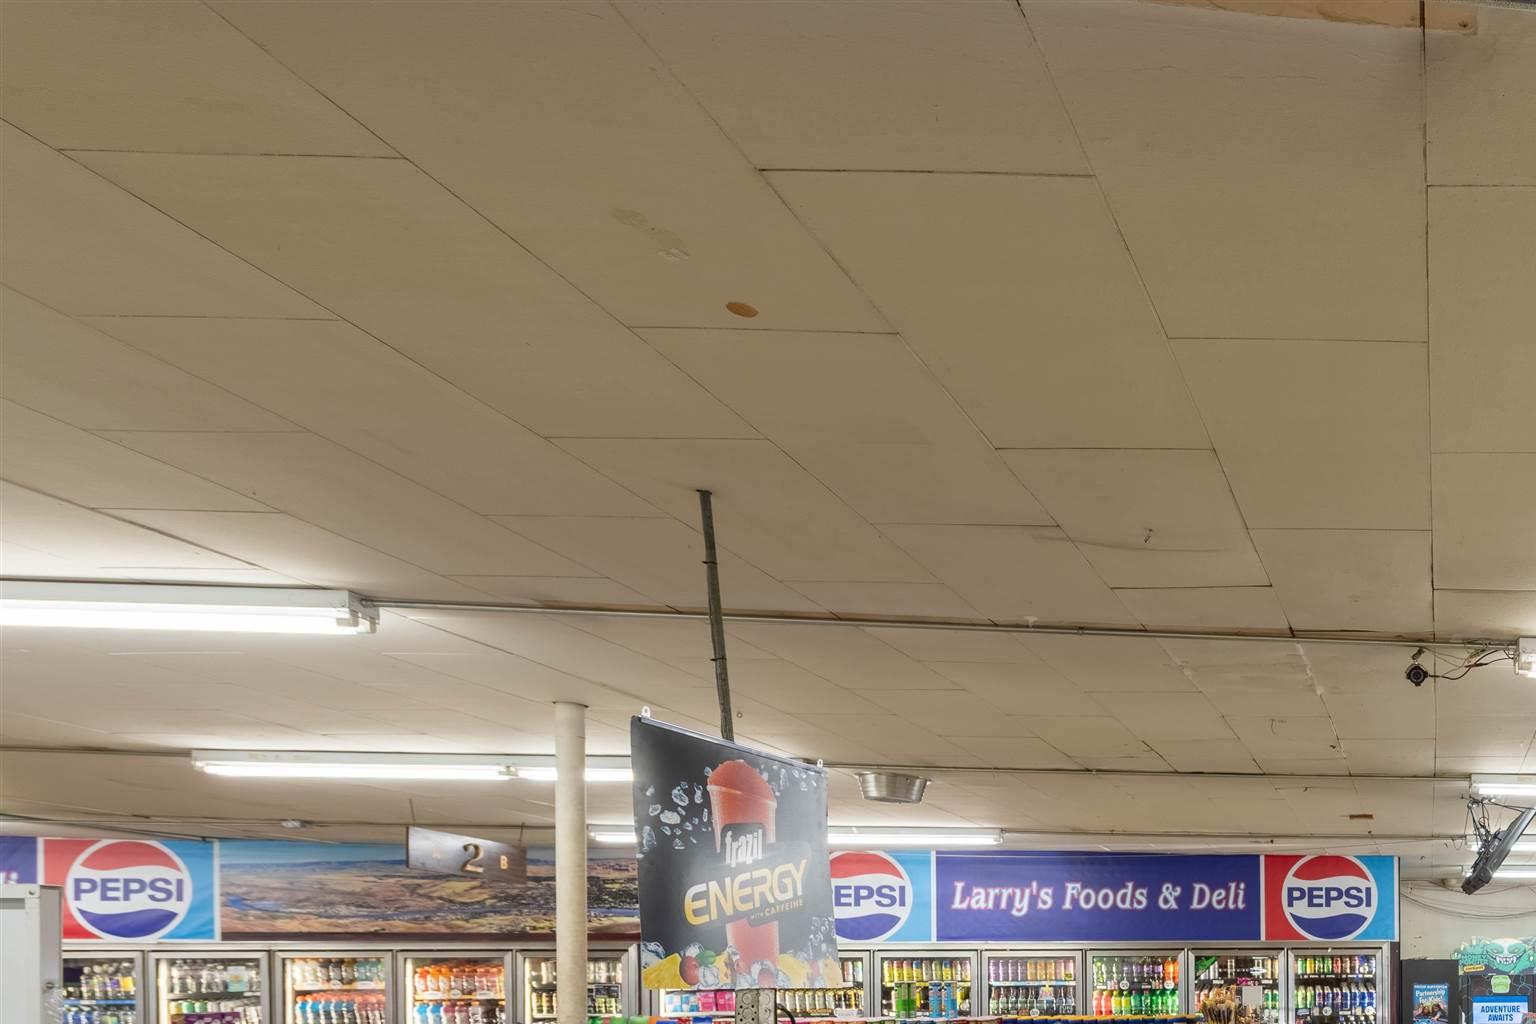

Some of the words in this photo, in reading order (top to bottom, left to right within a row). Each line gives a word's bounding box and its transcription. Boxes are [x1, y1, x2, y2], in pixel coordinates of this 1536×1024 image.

[463, 843, 484, 873] 2
[725, 828, 763, 868] frazil
[499, 855, 508, 870] B
[72, 877, 184, 903] PEPSI
[684, 859, 808, 926] ENERGY
[831, 884, 907, 908] EPSI
[951, 880, 1052, 918] Larry's
[1062, 881, 1148, 911] Foods
[1157, 881, 1181, 911] &
[1190, 880, 1246, 911] Deli
[1287, 884, 1373, 910] PEPSI
[764, 898, 804, 918] CAFFEINE
[1415, 989, 1446, 999] Partnership
[1481, 1005, 1520, 1013] ADVENTURE
[1488, 1014, 1513, 1022] AWAITS
